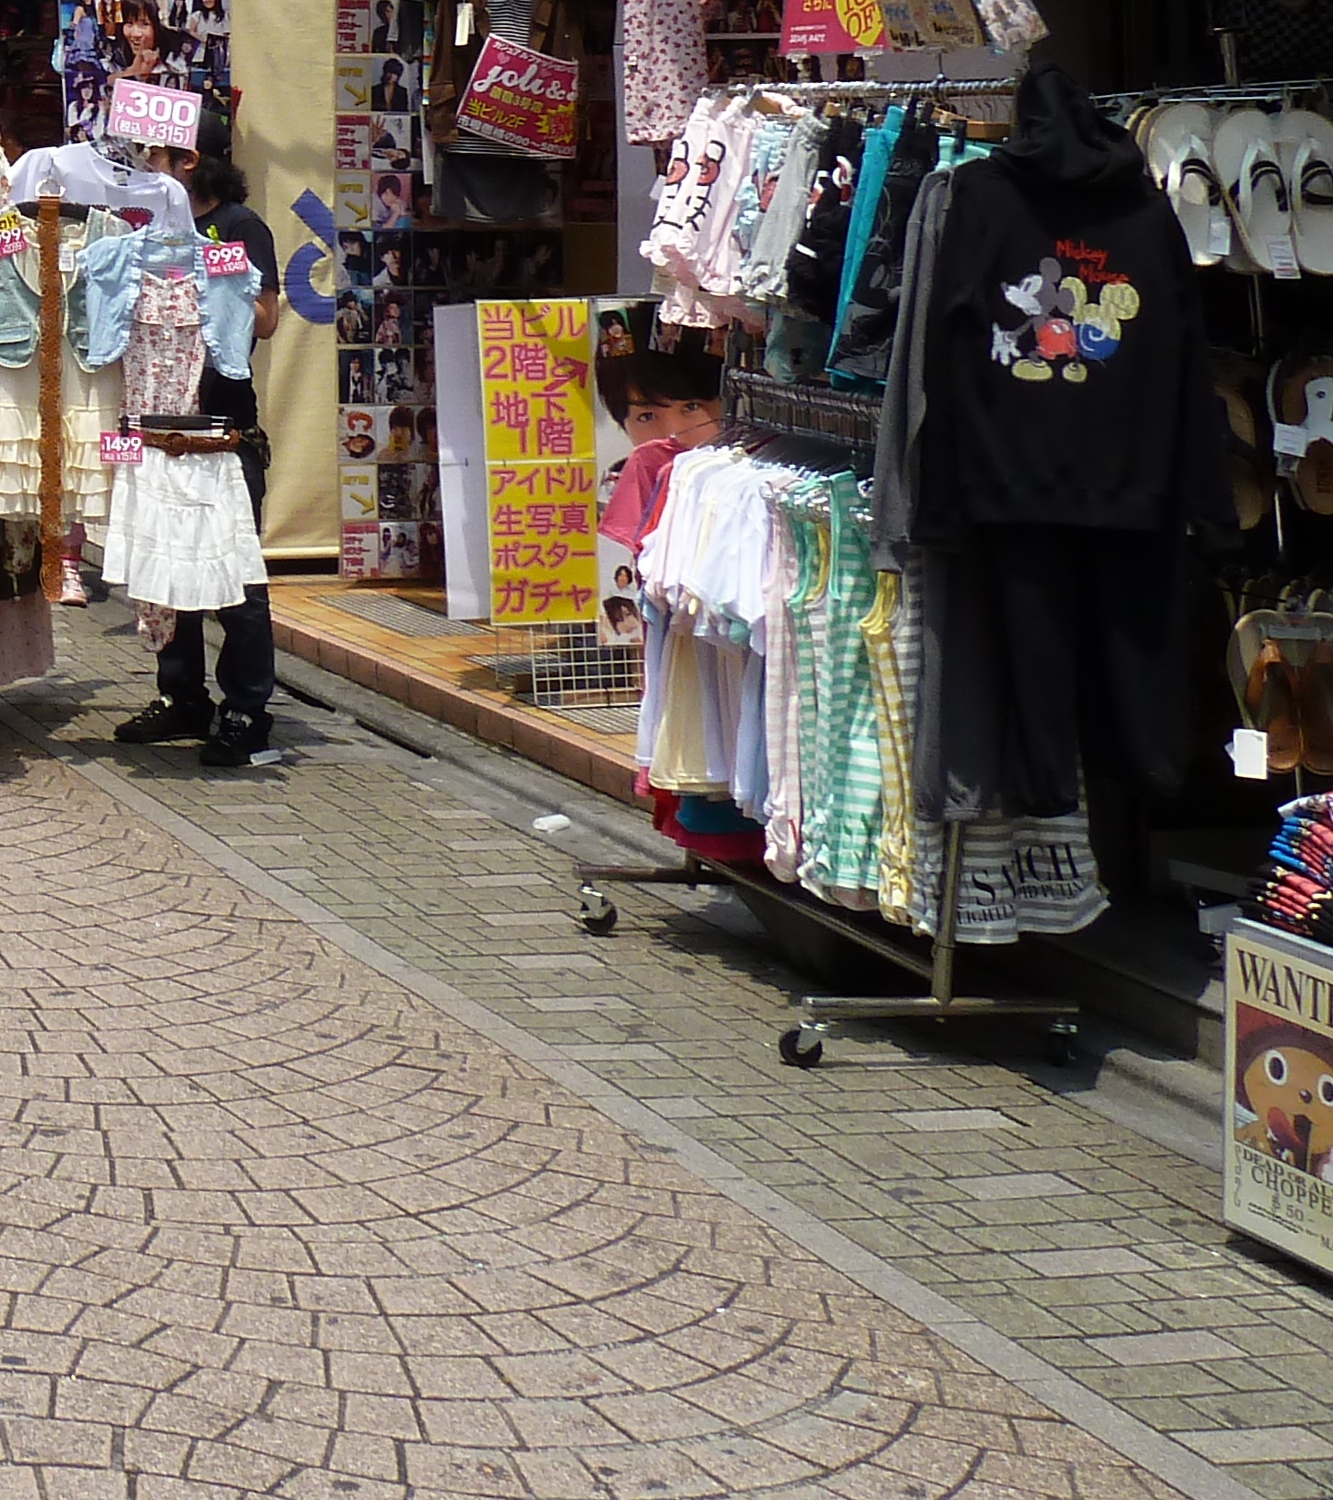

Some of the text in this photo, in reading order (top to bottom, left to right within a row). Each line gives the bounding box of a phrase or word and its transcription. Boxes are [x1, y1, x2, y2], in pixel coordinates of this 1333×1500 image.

[115, 90, 196, 128] ¥300
[146, 123, 191, 145] ¥315)
[491, 468, 593, 496] アイドル
[493, 503, 589, 537] 生写真
[494, 541, 596, 570] ポスター
[496, 578, 594, 615] ガチャ
